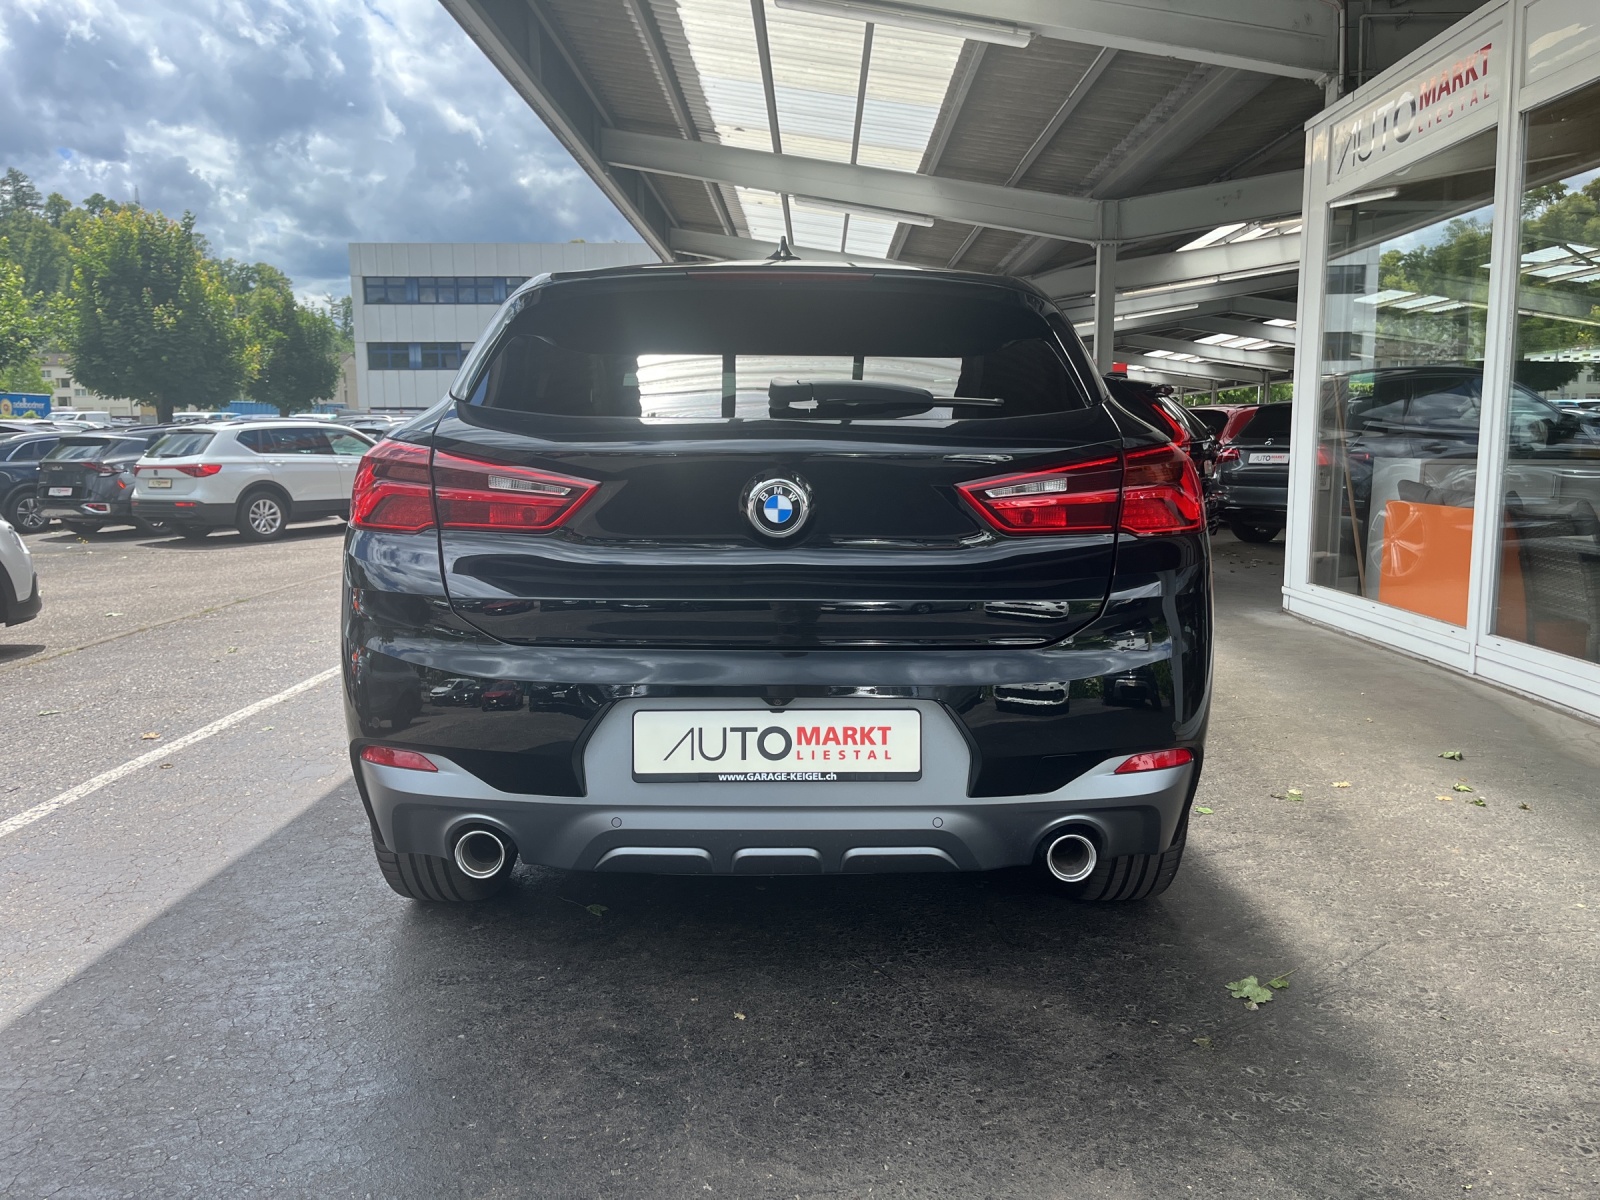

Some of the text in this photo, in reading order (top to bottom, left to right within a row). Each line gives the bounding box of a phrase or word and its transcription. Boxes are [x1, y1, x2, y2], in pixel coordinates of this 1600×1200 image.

[1337, 43, 1492, 175] AUTO MARKT
[1417, 84, 1491, 133] LIESTAL
[759, 486, 798, 502] BMW
[663, 725, 892, 762] AUTO MARKT
[796, 749, 892, 761] LIESTAL
[718, 773, 837, 782] www.GARAGE-KEIGEL.ch
